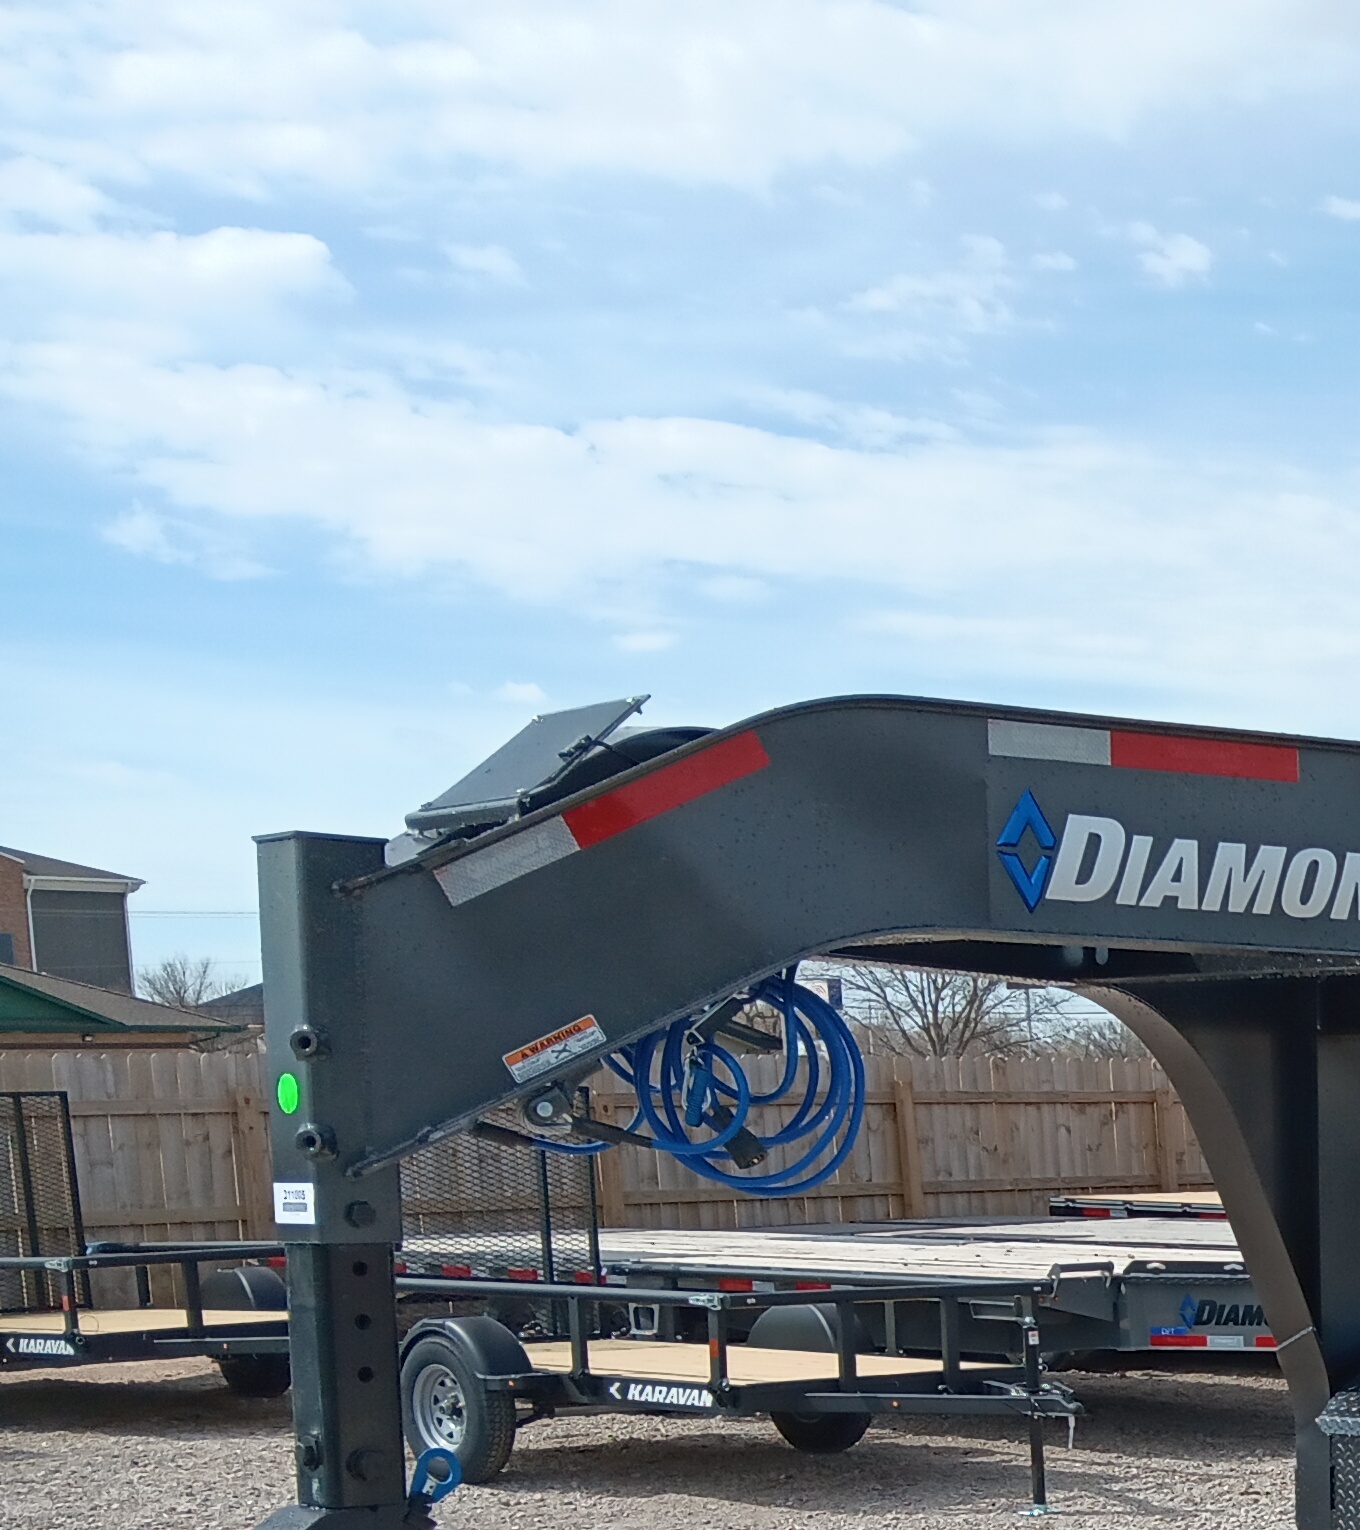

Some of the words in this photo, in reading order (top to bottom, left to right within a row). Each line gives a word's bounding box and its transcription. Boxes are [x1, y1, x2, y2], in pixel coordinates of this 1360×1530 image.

[528, 1023, 583, 1055] WARNING
[1193, 1300, 1270, 1327] DIAM
[627, 1383, 714, 1408] KARAVAN
